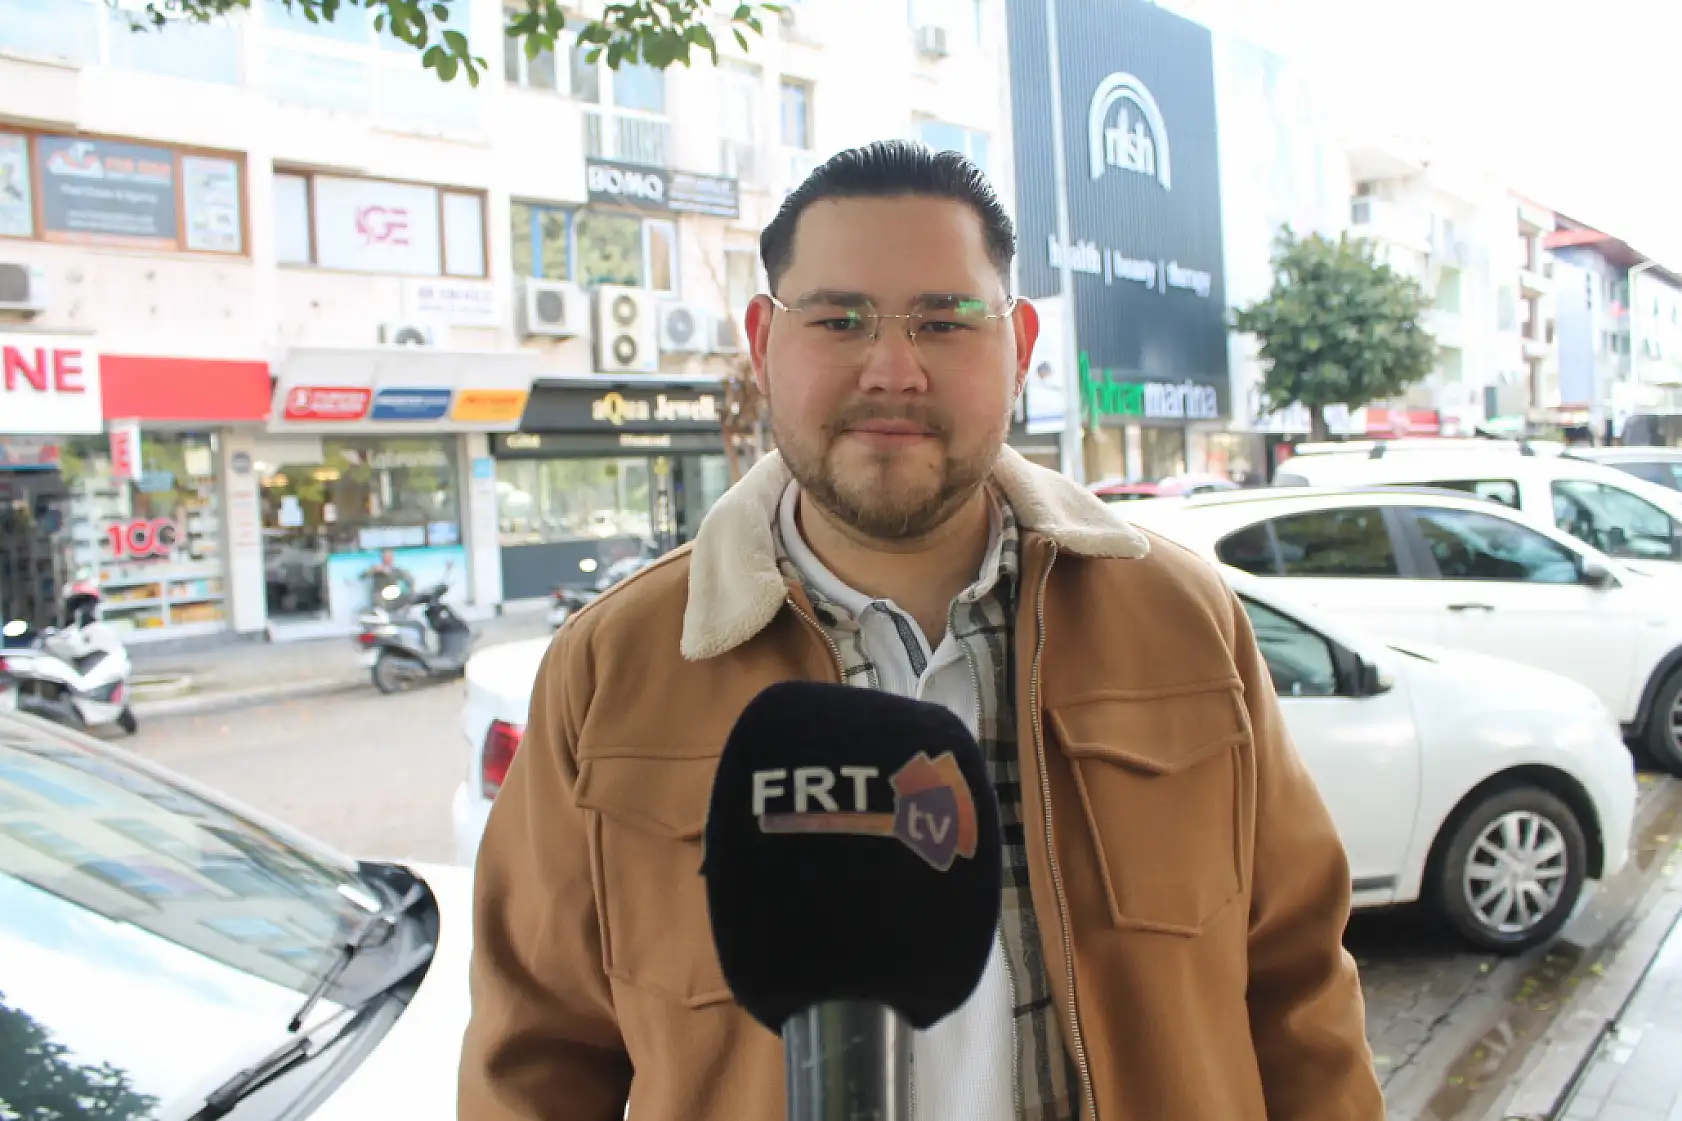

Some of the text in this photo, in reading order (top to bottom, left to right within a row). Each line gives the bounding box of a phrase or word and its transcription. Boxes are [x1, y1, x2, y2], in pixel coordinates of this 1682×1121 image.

[1048, 232, 1102, 274] halth
[3, 345, 86, 393] NE
[752, 766, 880, 817] FRT
[906, 803, 951, 844] tv
